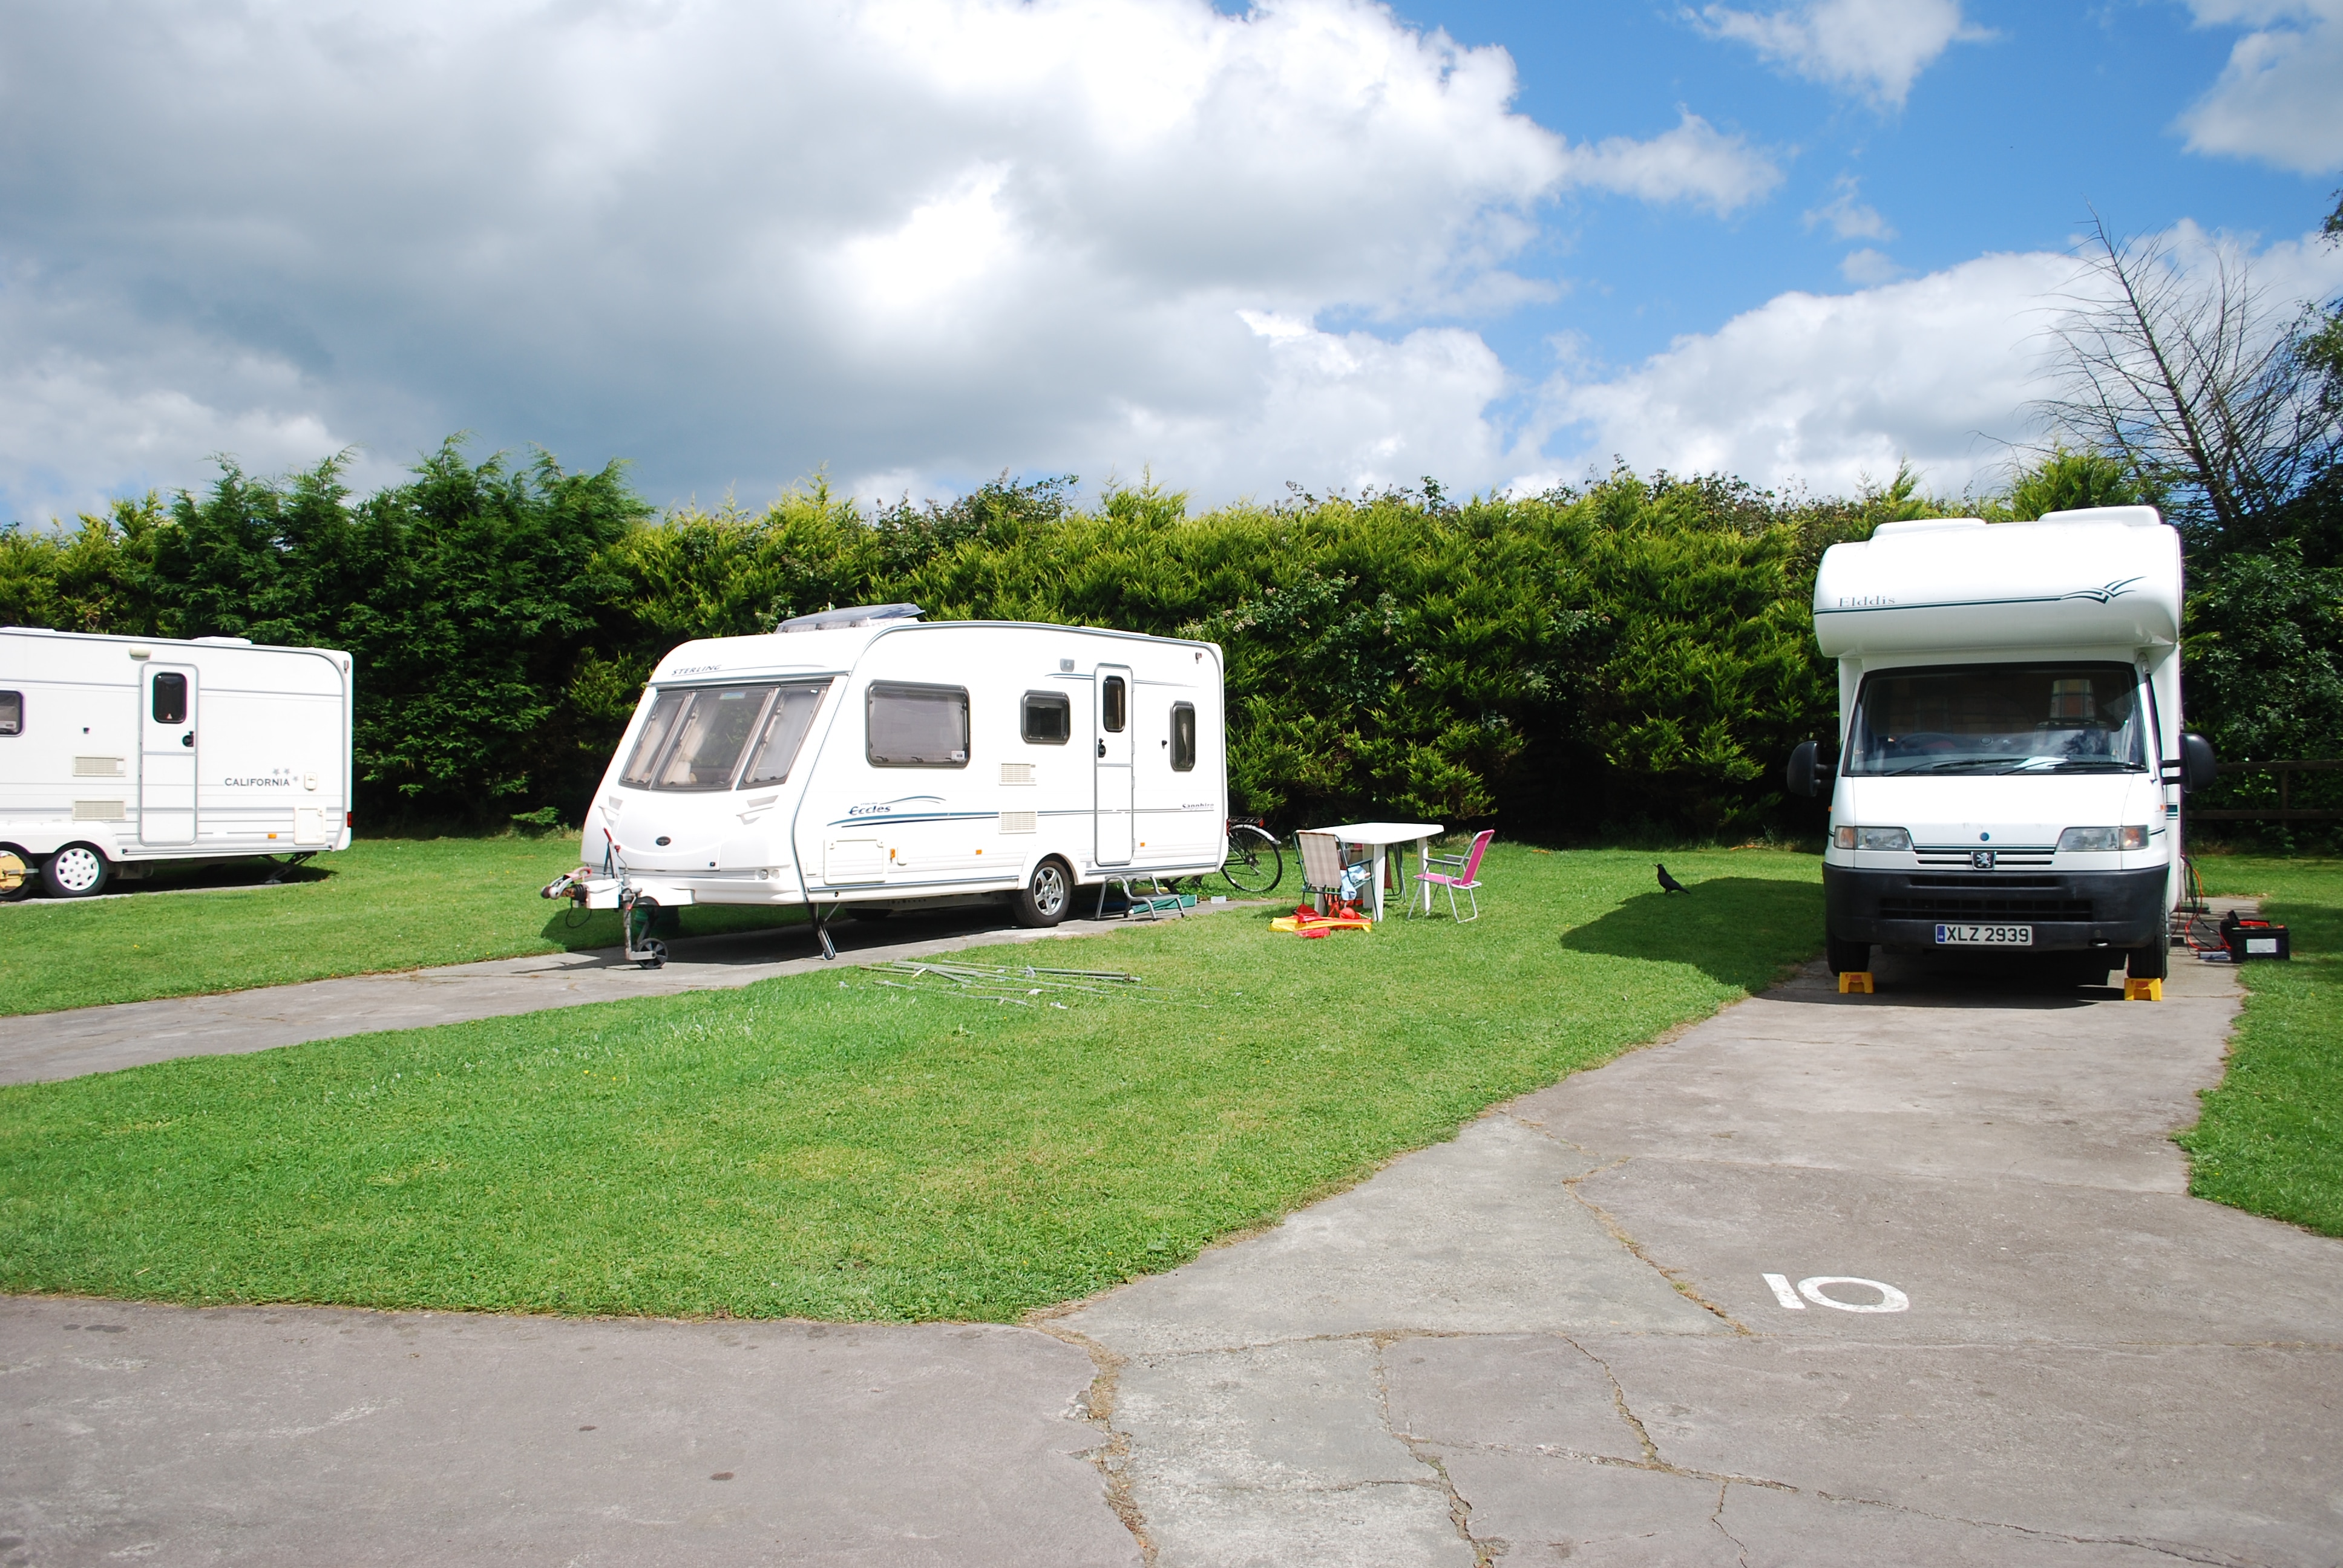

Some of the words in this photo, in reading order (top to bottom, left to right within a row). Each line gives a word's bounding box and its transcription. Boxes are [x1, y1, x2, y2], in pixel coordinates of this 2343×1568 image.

[1839, 595, 1895, 607] Elddis
[671, 665, 722, 676] STERLING
[224, 778, 290, 786] CALIFORNIA
[848, 806, 891, 815] Eccles
[1947, 927, 1979, 941] XLZ
[1984, 927, 2029, 942] 2939
[1762, 1273, 1909, 1313] 10
